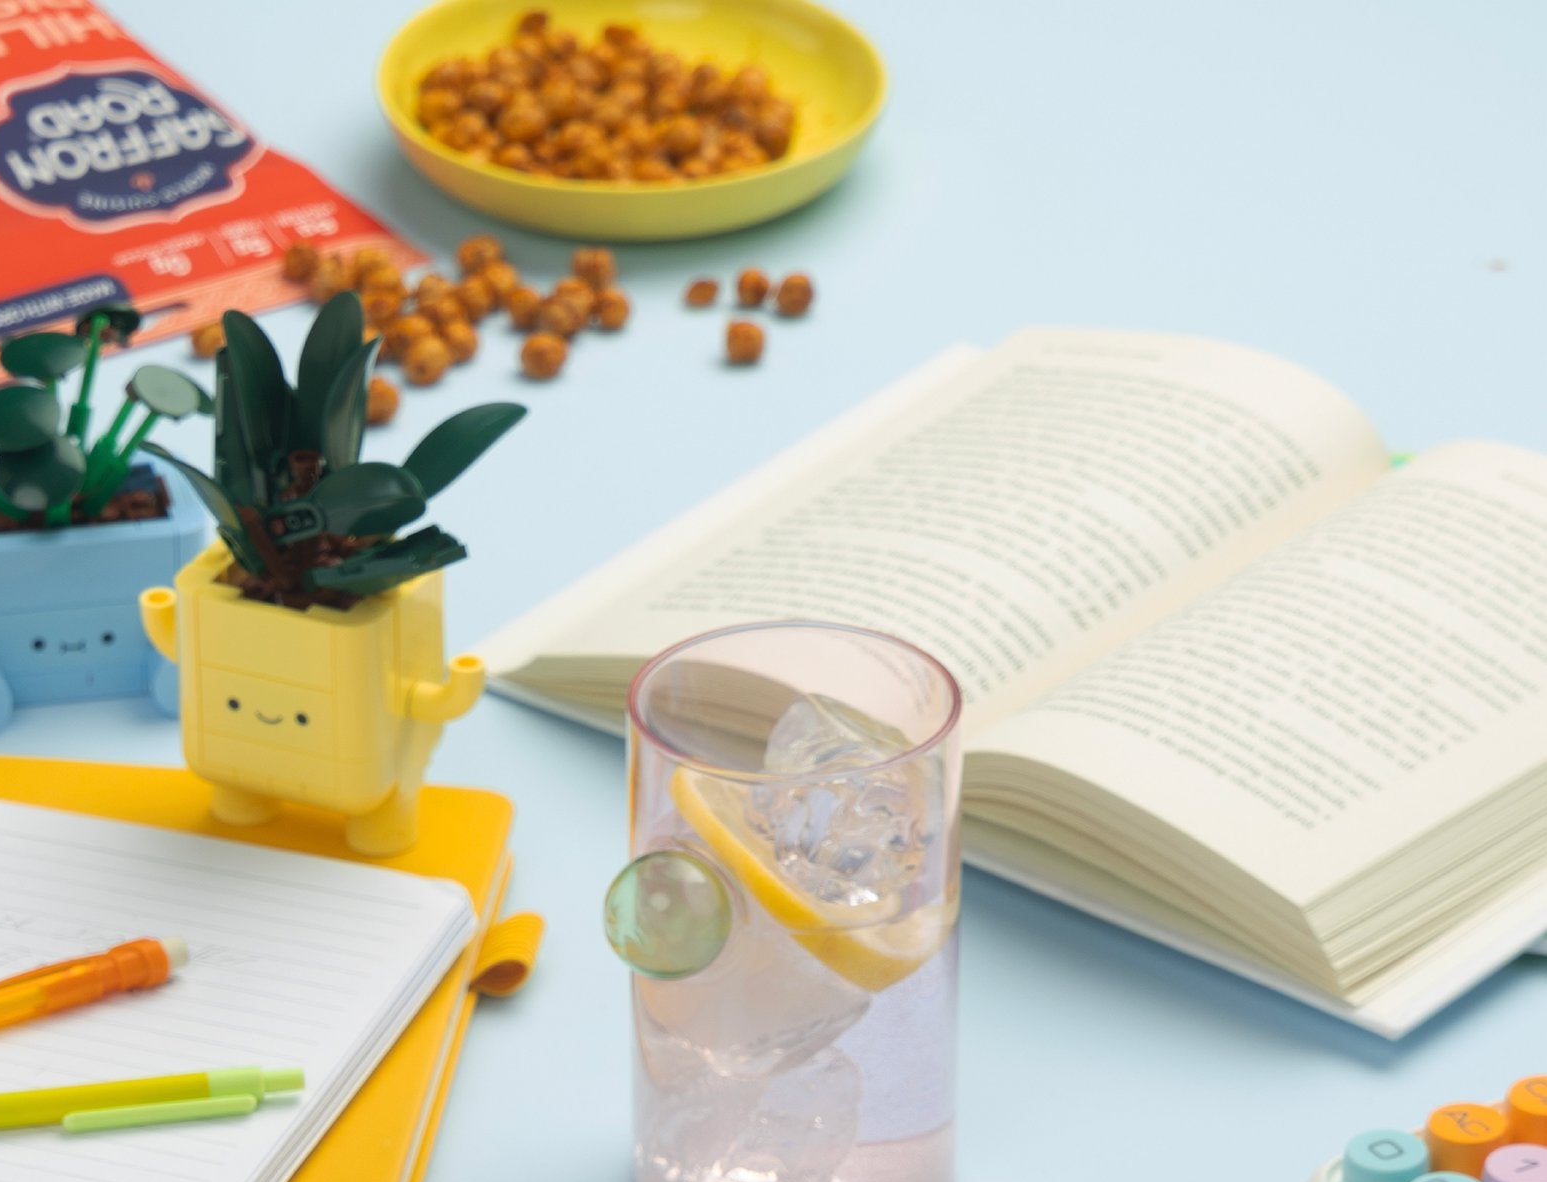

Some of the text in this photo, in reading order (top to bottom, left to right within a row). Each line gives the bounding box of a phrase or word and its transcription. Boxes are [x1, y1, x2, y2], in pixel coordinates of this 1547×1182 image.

[26, 77, 180, 140] ROAD
[5, 108, 248, 190] SAFFRON
[1442, 1109, 1492, 1138] AC
